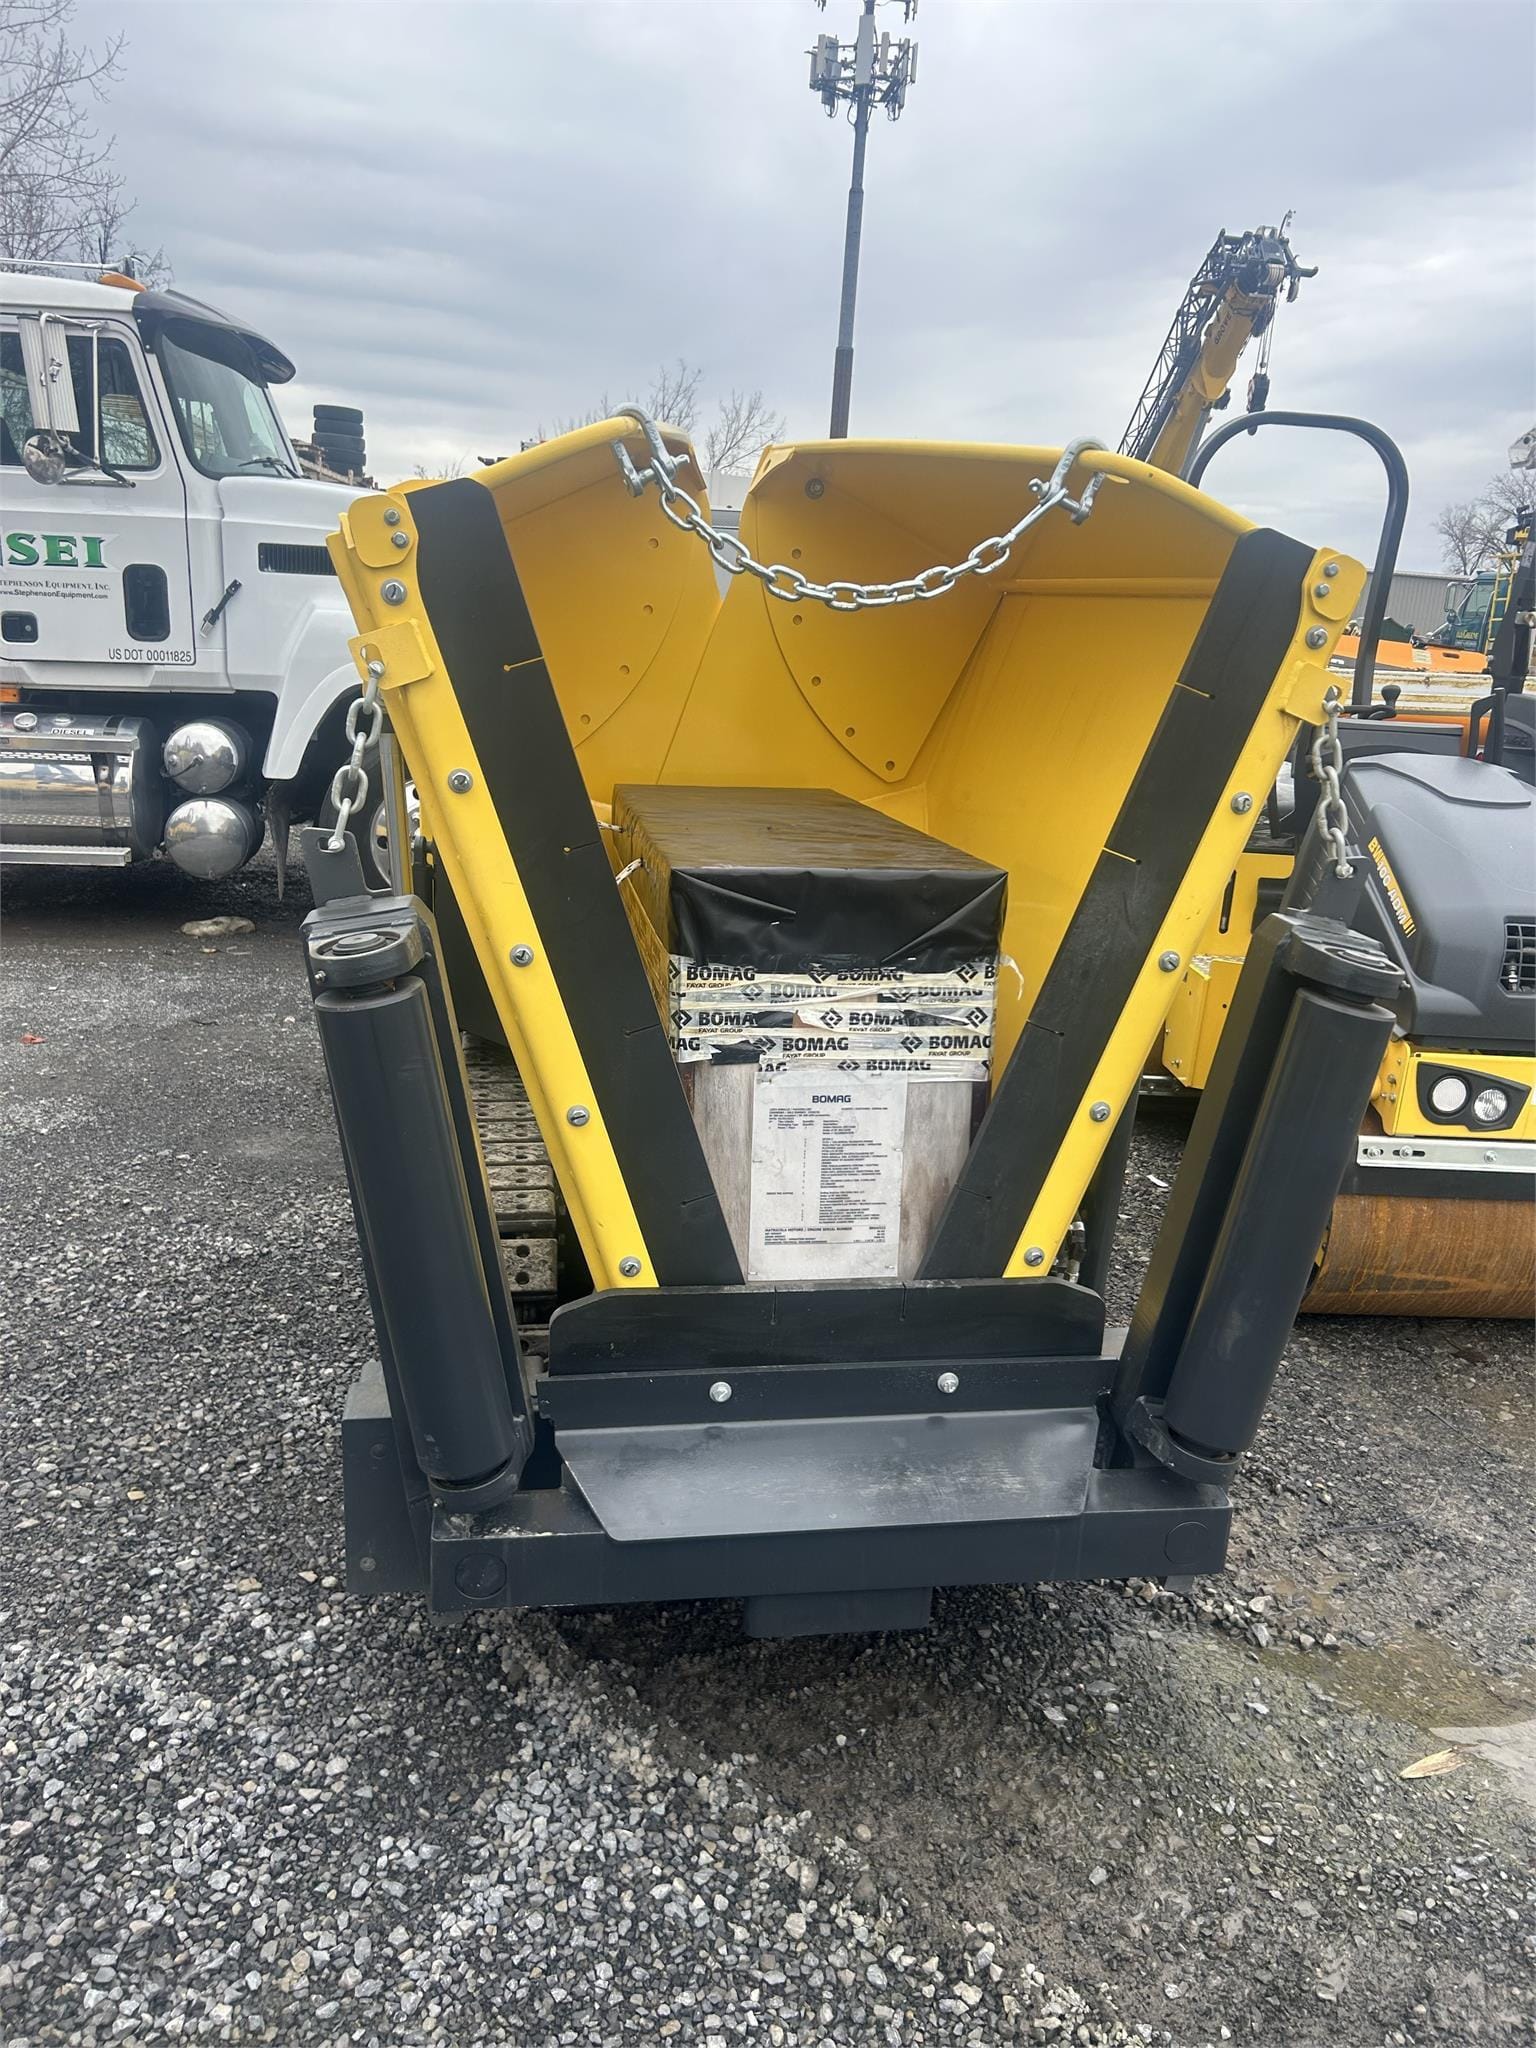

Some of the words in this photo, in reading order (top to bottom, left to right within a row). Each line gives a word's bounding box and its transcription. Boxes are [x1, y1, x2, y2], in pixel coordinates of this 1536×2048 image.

[6, 532, 108, 568] SEI
[108, 648, 122, 660] US
[124, 649, 143, 660] DOT
[146, 650, 192, 662] 00011825
[686, 966, 755, 981] BOMAG
[770, 983, 837, 998] BOMAG
[698, 1011, 754, 1026] BOMA
[849, 1012, 904, 1026] BOMA
[782, 1037, 849, 1051] BOMAG
[866, 1059, 931, 1071] BOMAG
[812, 1095, 852, 1103] BOMAG
